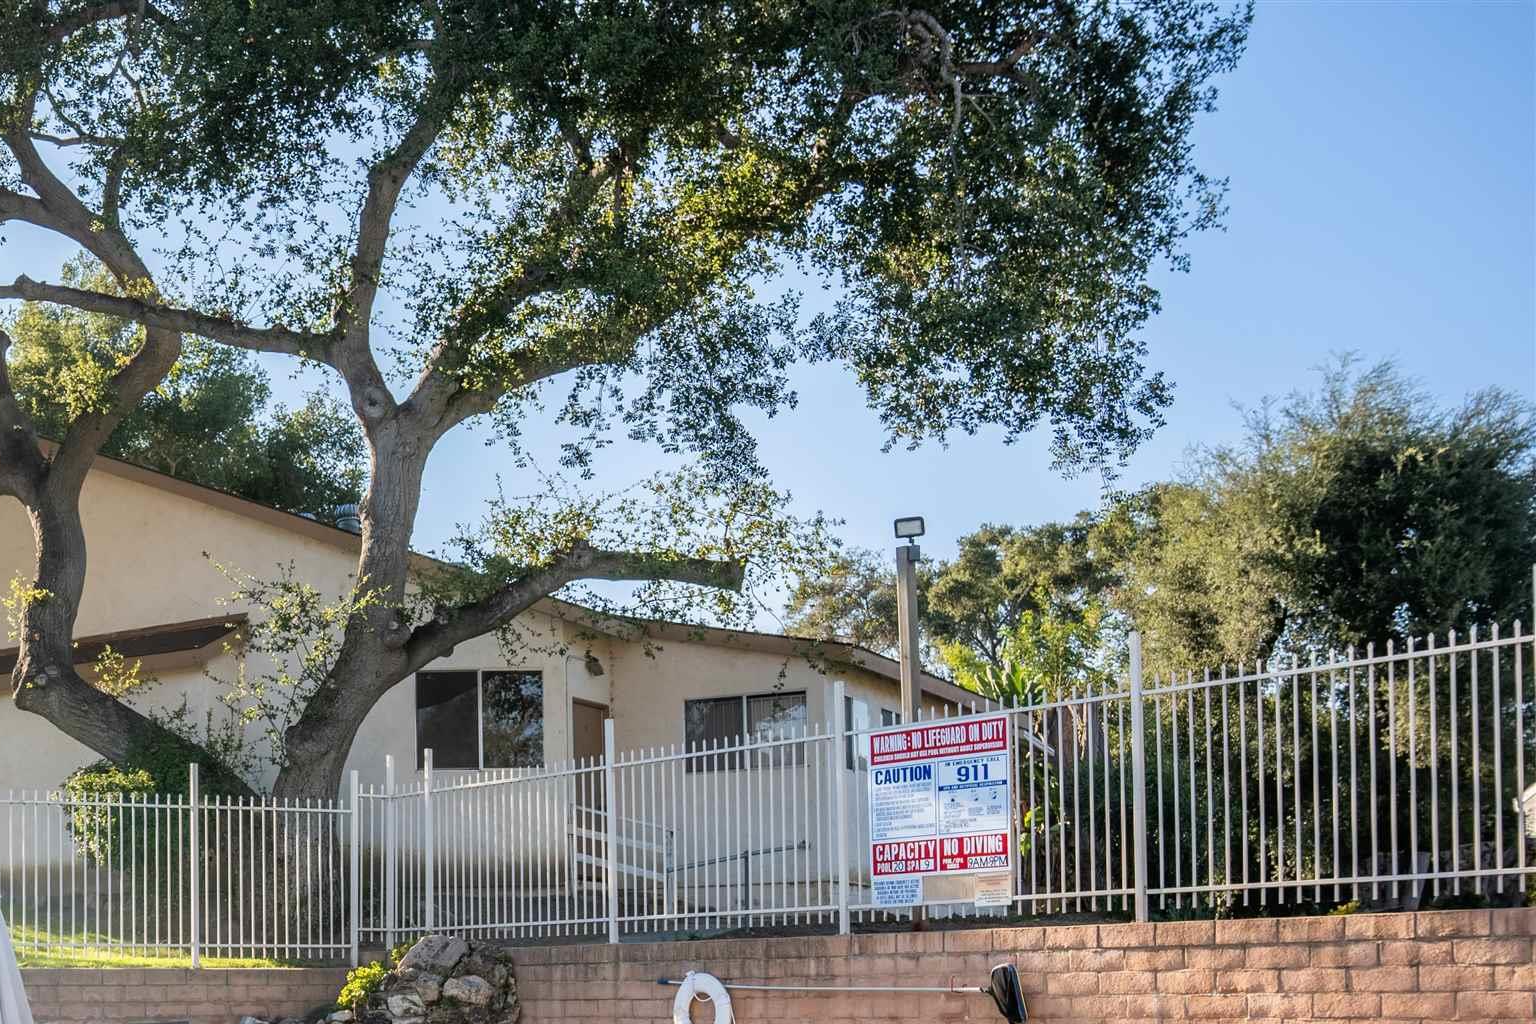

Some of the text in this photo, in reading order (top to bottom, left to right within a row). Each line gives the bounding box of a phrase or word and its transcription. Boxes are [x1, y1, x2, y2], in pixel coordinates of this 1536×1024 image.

[873, 720, 1004, 754] WARNING: NO LIFEGUARD ON DUTY
[875, 765, 932, 785] CAUTION
[957, 763, 989, 782] 911
[876, 840, 935, 862] CAPACITY
[943, 835, 1003, 856] NO DIVING
[877, 861, 892, 873] POOL
[894, 861, 905, 872] 20
[907, 860, 919, 871] SPA
